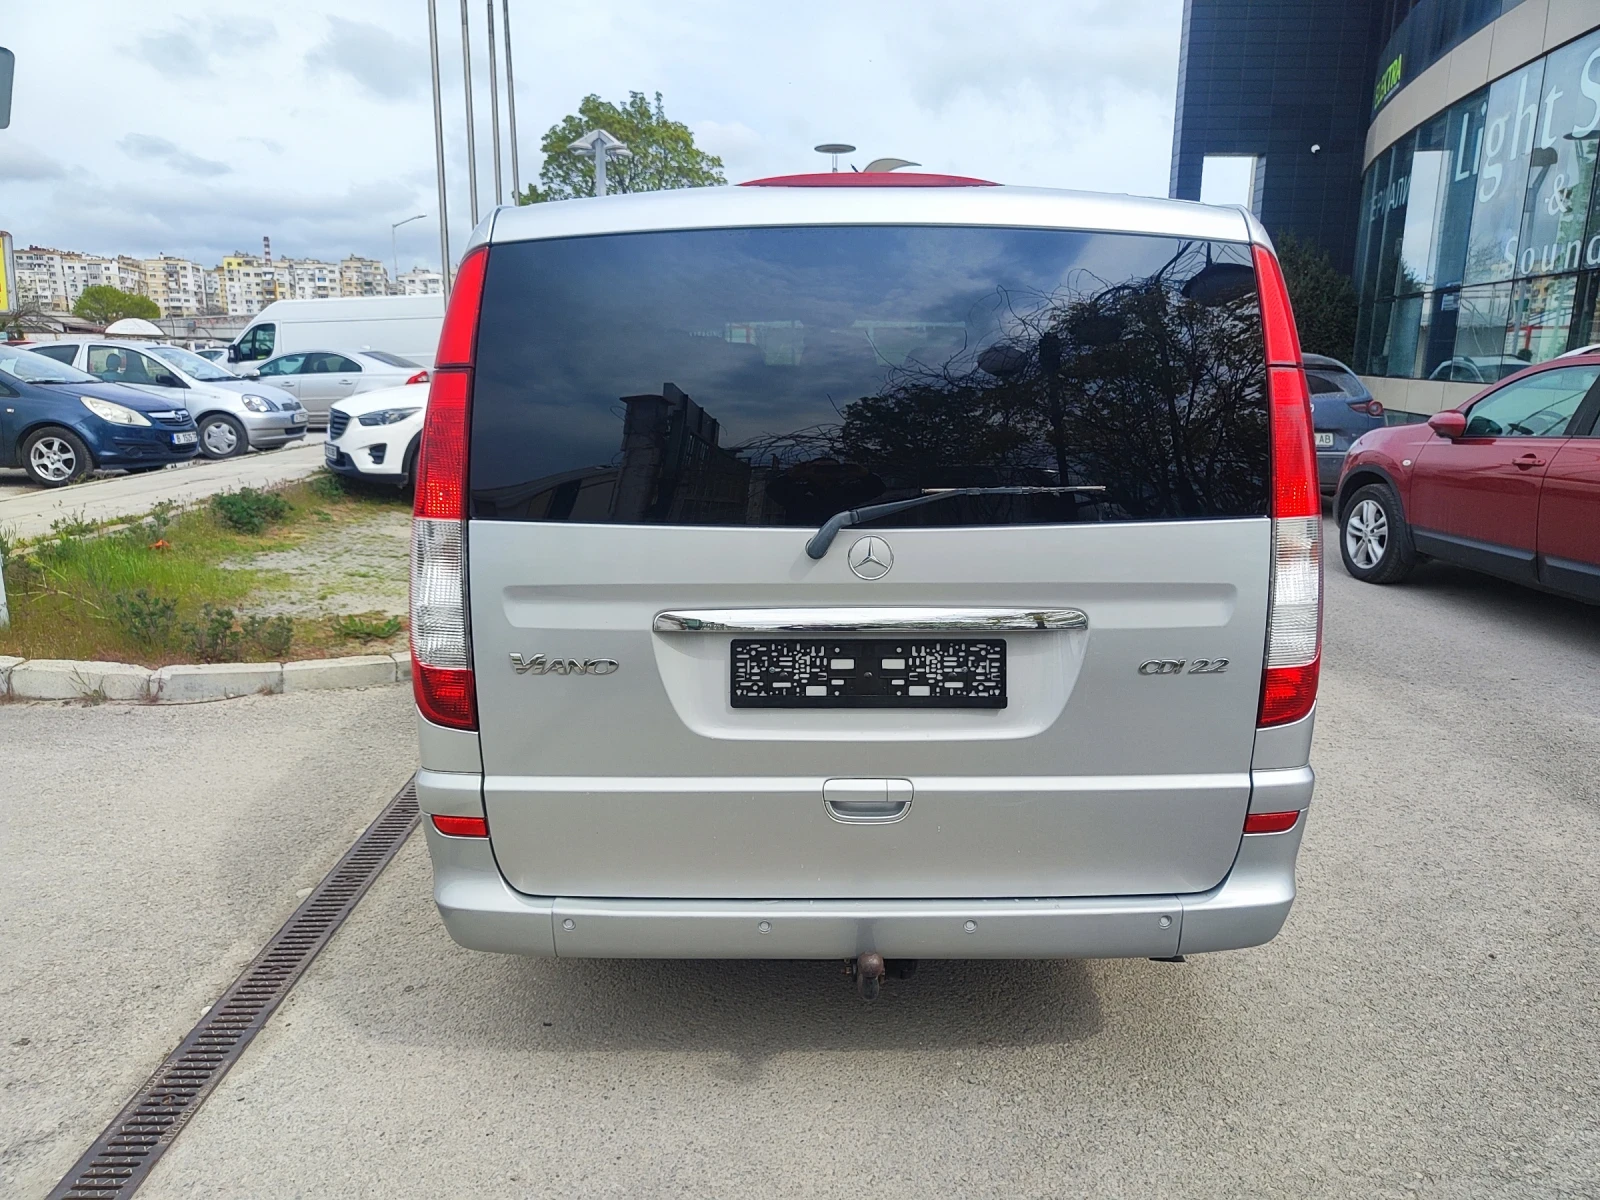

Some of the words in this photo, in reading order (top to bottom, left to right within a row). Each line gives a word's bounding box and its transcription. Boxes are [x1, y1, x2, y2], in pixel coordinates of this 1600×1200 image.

[1454, 72, 1563, 203] Light
[1545, 174, 1568, 216] &
[508, 652, 620, 676] VIANO
[1138, 658, 1187, 676] CDI
[1188, 657, 1230, 674] 22
